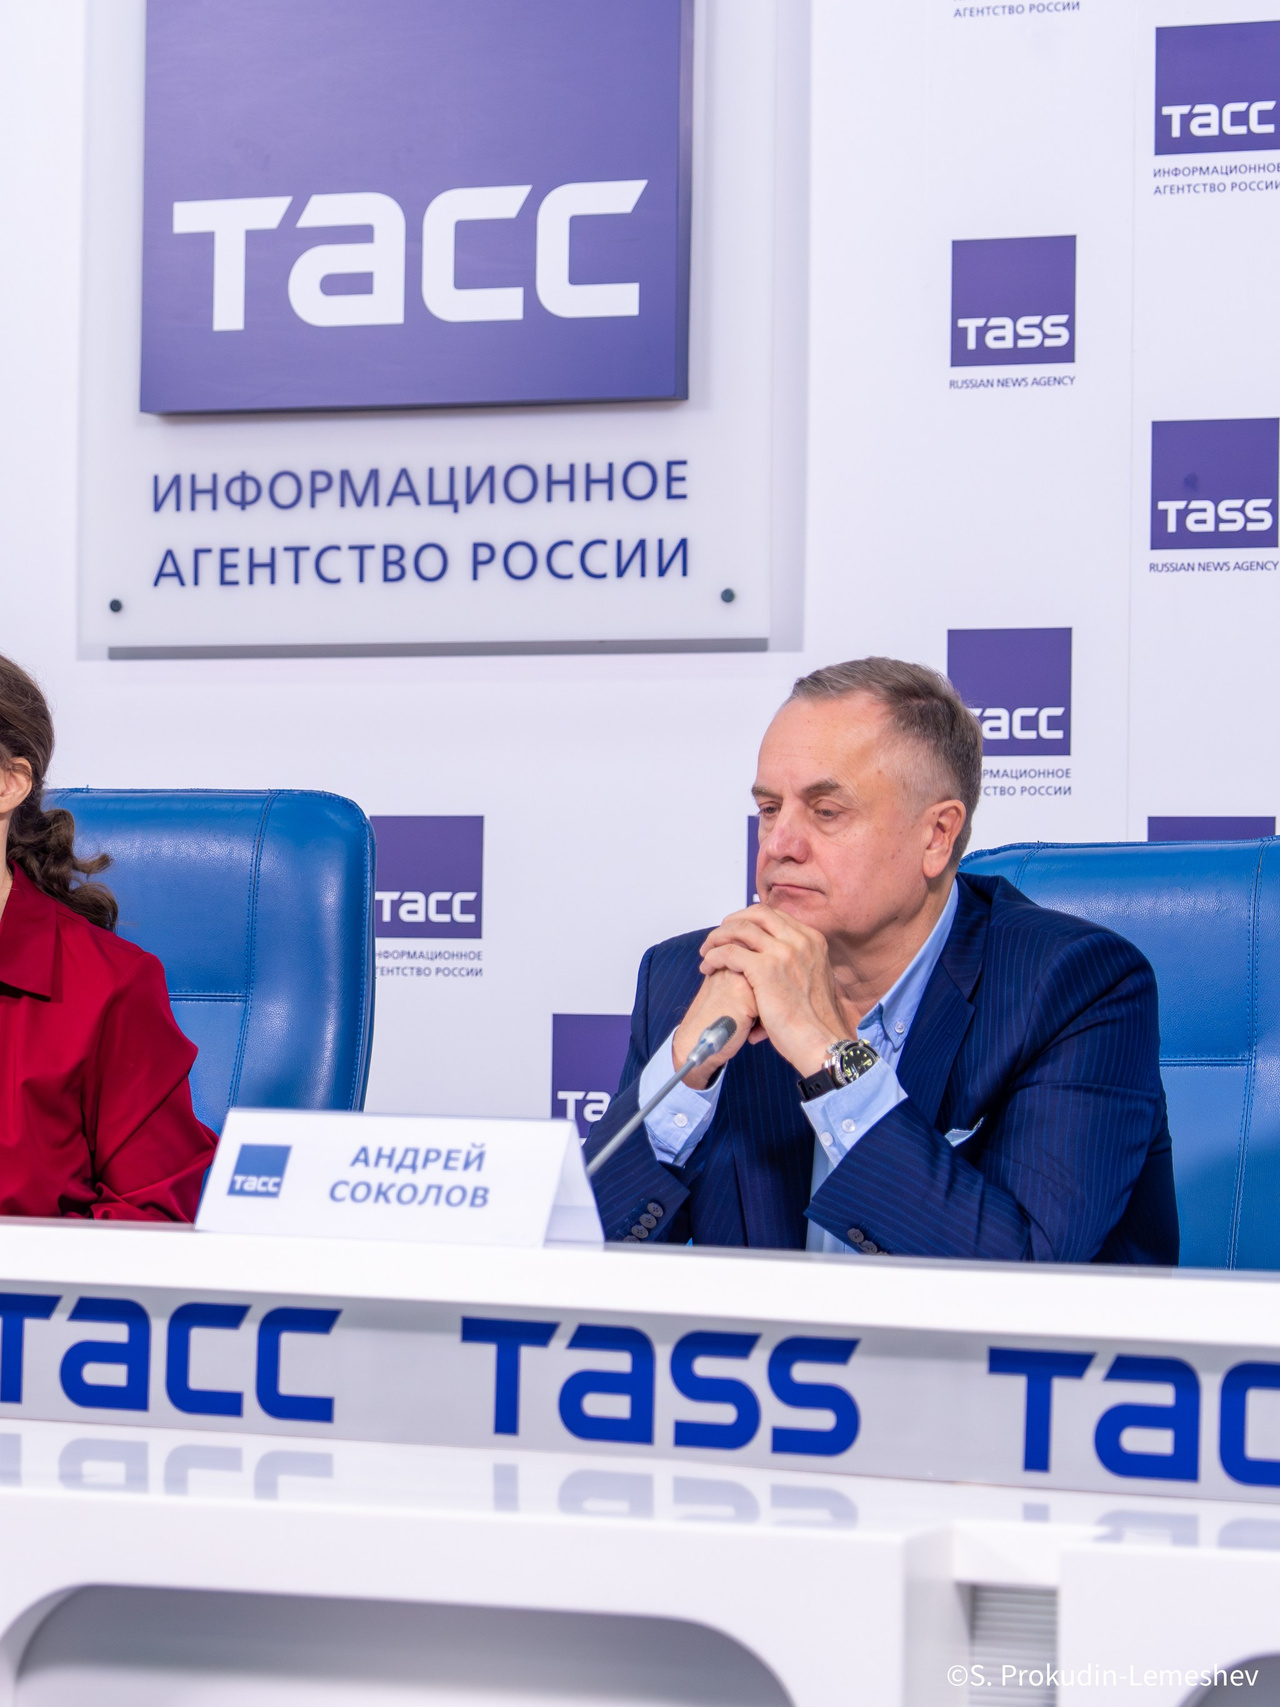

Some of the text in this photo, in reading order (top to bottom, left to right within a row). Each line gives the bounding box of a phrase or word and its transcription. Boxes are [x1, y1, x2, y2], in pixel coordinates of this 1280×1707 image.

[953, 1, 1080, 18] АГЕНТСТВО РОССИИ
[1153, 182, 1227, 195] АГЕНТСТВО
[949, 375, 1075, 390] RUSSIAN NEWS AGENCY
[152, 460, 689, 513] ИНФОРМАЦИОННОЕ
[153, 538, 689, 587] АГЕНТСТВО РОССИИ
[1149, 560, 1279, 573] RUSSIAN NEWS AGENCY
[983, 768, 1071, 780] РМАЦИОННОЕ
[1020, 786, 1071, 796] РОССИИ
[376, 950, 482, 961] НФОРМАЦИОННОЕ
[376, 966, 482, 977] ЕНТСТВО РОССИИ
[350, 1142, 486, 1174] АНДРЕЙ
[329, 1180, 490, 1208] СОКОЛОВ
[987, 1345, 1280, 1488] ТАС
